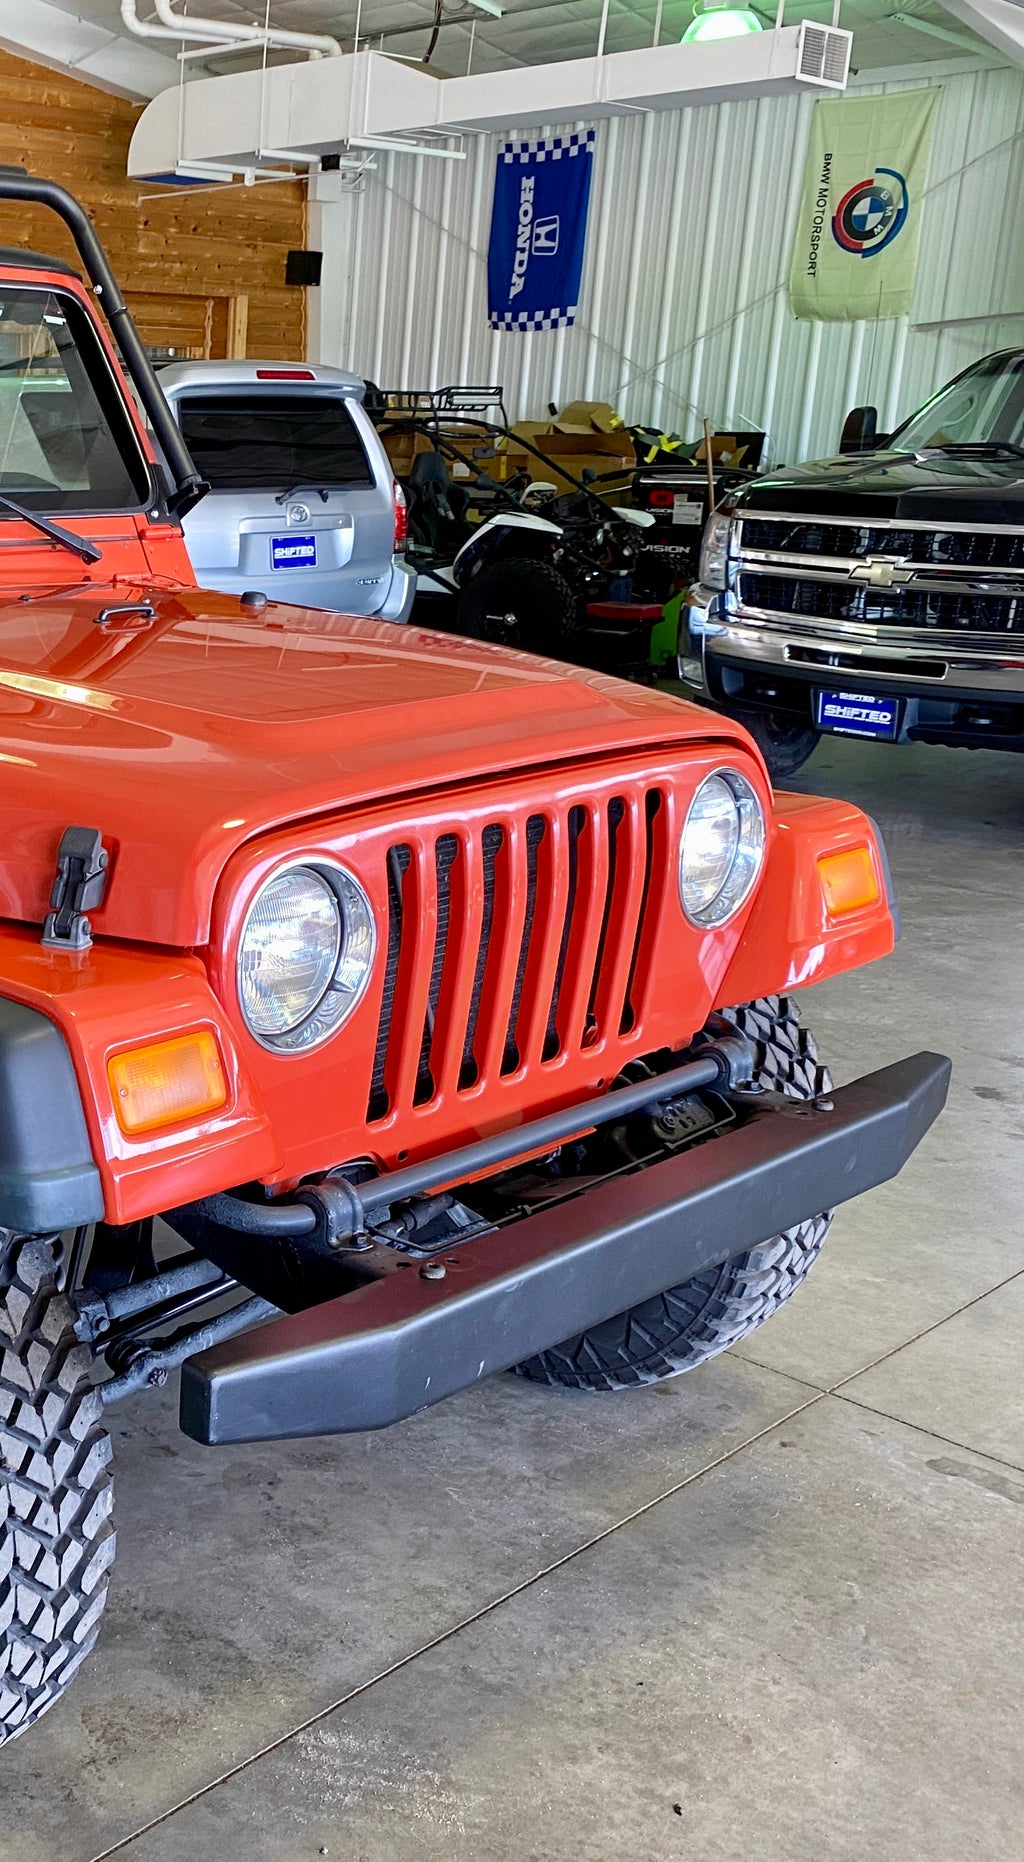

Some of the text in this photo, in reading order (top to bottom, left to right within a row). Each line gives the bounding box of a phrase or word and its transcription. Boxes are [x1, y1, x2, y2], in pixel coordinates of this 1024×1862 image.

[509, 176, 535, 299] HONDA
[807, 153, 832, 277] BMW MOTORSPORT
[874, 190, 894, 235] BMW
